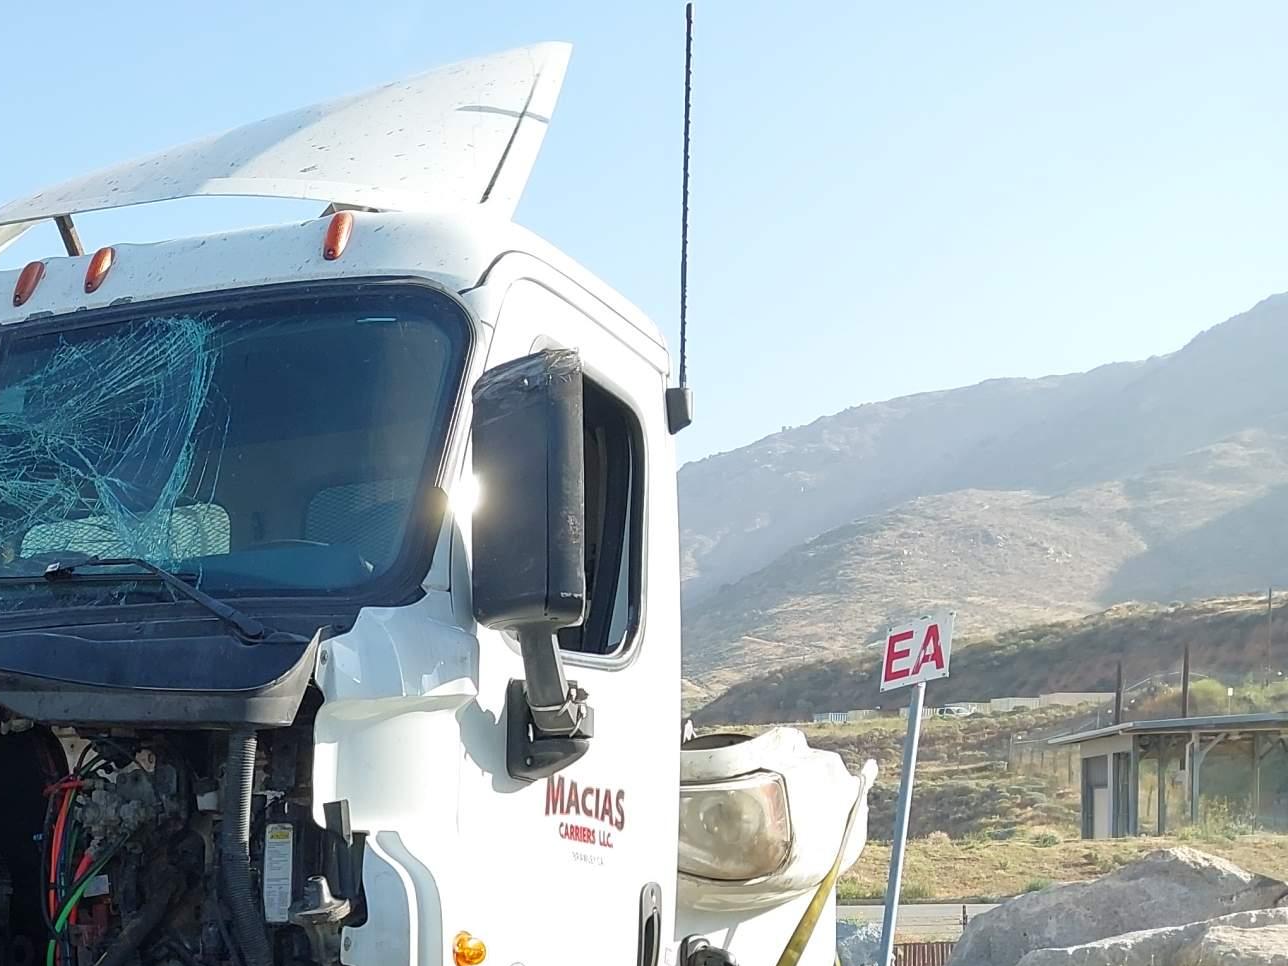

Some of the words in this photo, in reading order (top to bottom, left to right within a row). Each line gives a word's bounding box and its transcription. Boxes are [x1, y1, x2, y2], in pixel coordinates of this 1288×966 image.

[884, 623, 945, 682] EA
[545, 775, 625, 832] MACIAS
[559, 822, 596, 845] CARRIERS
